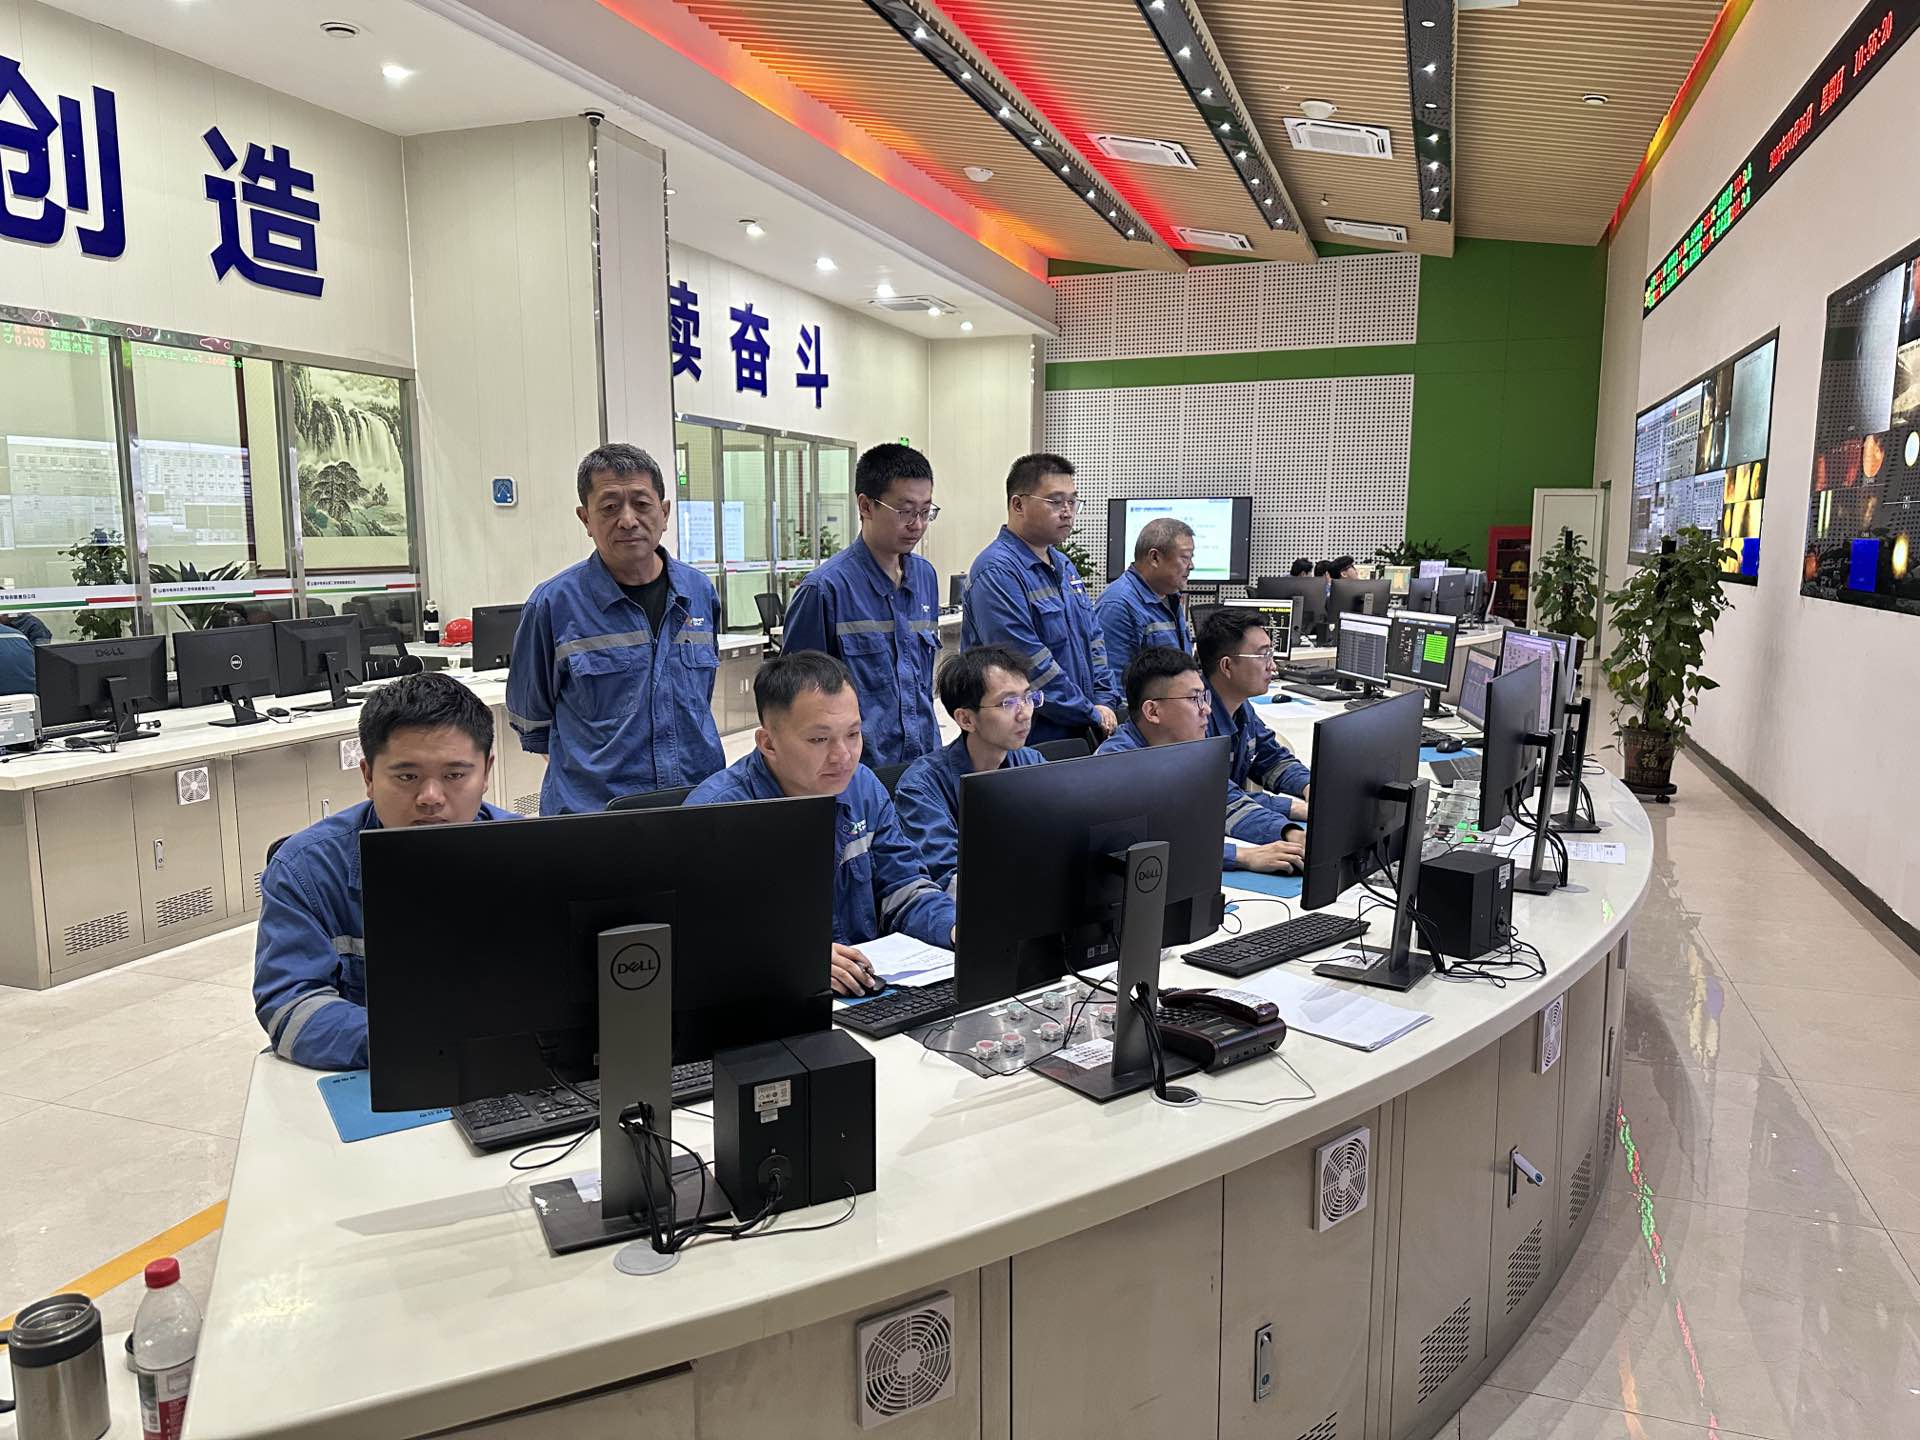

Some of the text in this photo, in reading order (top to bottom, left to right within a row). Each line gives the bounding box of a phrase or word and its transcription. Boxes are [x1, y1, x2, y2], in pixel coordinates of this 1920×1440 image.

[0, 54, 325, 299] 创造
[95, 647, 125, 658] DELL
[1138, 868, 1161, 881] DELL
[617, 959, 657, 974] DELL
